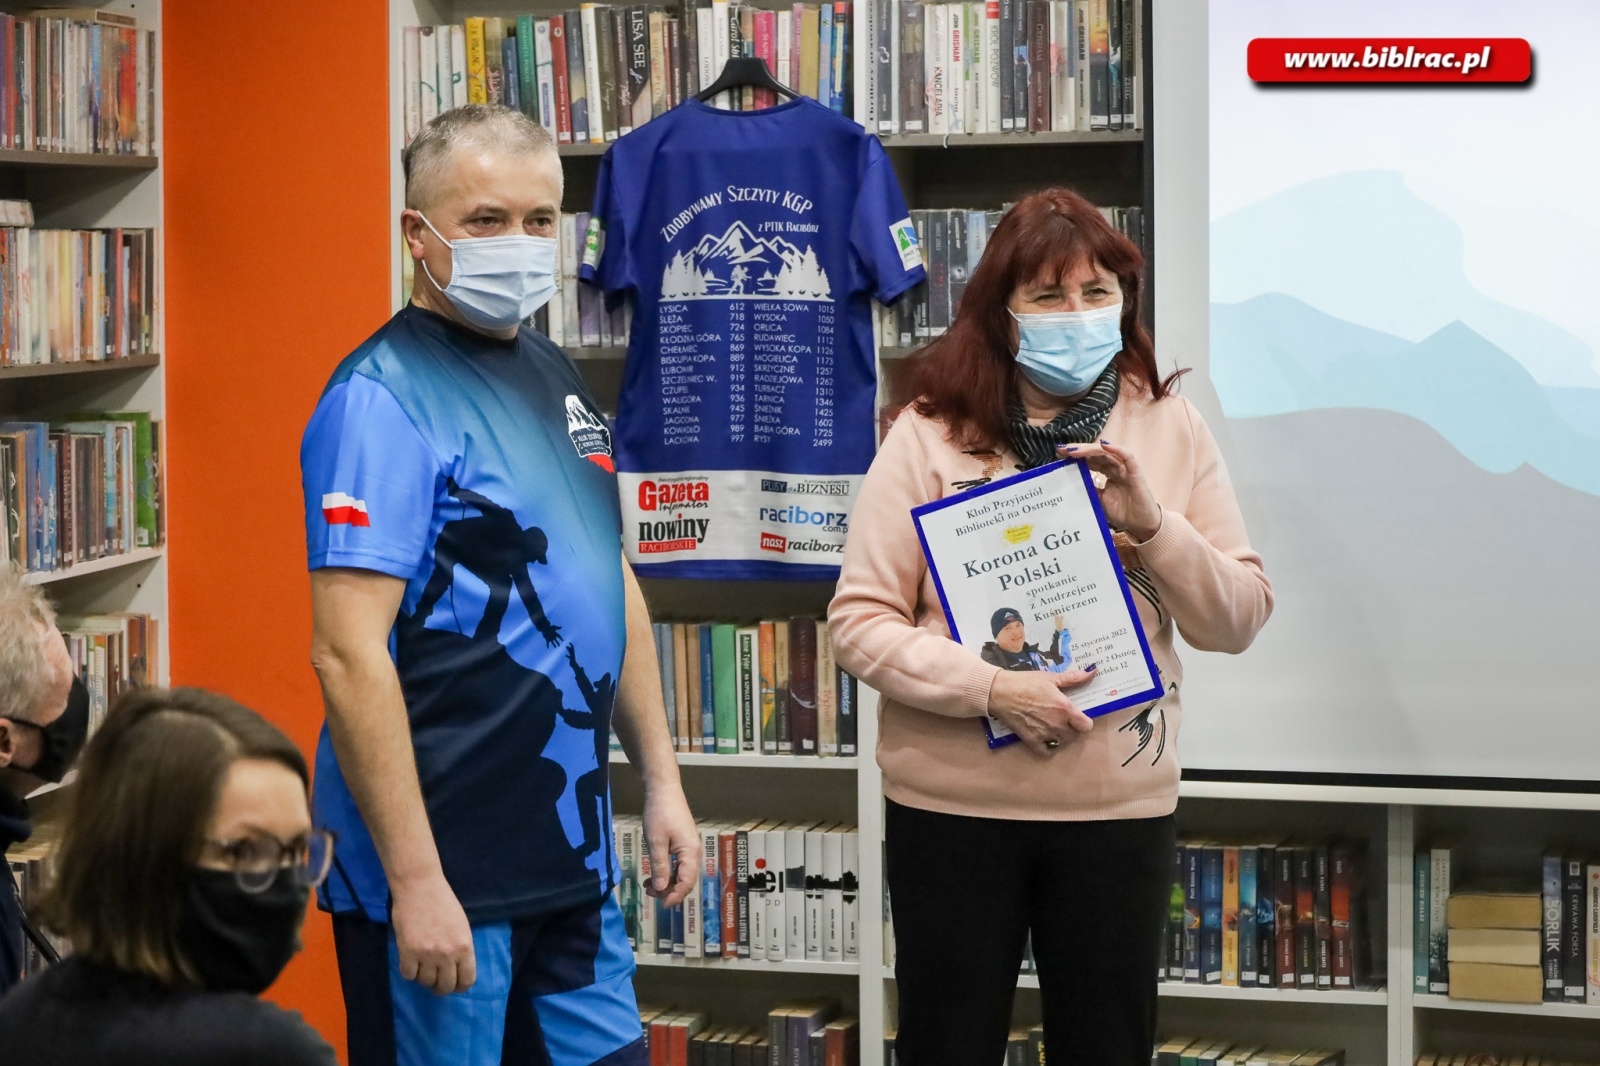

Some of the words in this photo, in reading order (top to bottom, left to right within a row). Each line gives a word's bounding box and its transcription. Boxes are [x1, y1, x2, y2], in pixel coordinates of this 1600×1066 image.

[632, 10, 643, 41] LISA
[1036, 24, 1044, 61] GRISHAM
[471, 38, 480, 66] ROWLING
[634, 44, 645, 68] SEE
[934, 67, 942, 116] KANCELARIA
[660, 192, 722, 243] ZDOBYWAMY
[727, 185, 780, 203] SZCZYTY
[782, 191, 813, 214] KGP
[765, 222, 783, 232] PTTK
[660, 305, 688, 313] ŁYSICA
[729, 303, 745, 311] 612
[754, 303, 780, 311] WIELKA
[783, 303, 809, 311] SOWA
[819, 305, 835, 313] 1015
[660, 325, 692, 334] SKOPIEC
[729, 323, 745, 331] 724
[819, 316, 834, 324] 1050
[696, 333, 721, 342] GÓRA
[818, 326, 833, 334] 1084
[730, 344, 745, 352] 869
[754, 334, 795, 342] RUDAWIEC
[818, 336, 833, 345] 1112
[754, 344, 785, 352] WYSOKA
[788, 345, 811, 353] KOPA
[817, 346, 833, 355] 1126
[817, 357, 833, 365] 1173
[816, 367, 833, 375] 1257
[754, 385, 785, 393] TURBACZ
[816, 388, 833, 396] 1310
[816, 378, 833, 386] 1262
[730, 394, 745, 402] 936
[816, 398, 833, 406] 1346
[815, 408, 833, 416] 1425
[776, 426, 800, 435] GÓRA
[814, 429, 833, 437] 1725
[815, 419, 833, 427] 1602
[754, 435, 771, 443] RYSY
[813, 439, 832, 447] 2499
[639, 480, 709, 511] Gazeta
[797, 483, 849, 495] BIZNESU
[966, 504, 991, 519] Klub
[993, 487, 1043, 510] Przyjaciół
[760, 506, 847, 526] raciborz
[955, 513, 1005, 537] Biblioteki
[1008, 510, 1020, 519] na
[1022, 495, 1063, 514] Ostrogu
[638, 513, 710, 543] nowiny
[823, 526, 848, 534] com.p
[763, 538, 783, 548] nasz
[962, 545, 1038, 578] Korona
[1043, 530, 1081, 551] Gór
[997, 558, 1062, 592] Polski
[1026, 574, 1078, 598] spotkanie
[1040, 582, 1097, 606] Andrzejem
[1033, 595, 1098, 622] Kuśnierzem
[1081, 635, 1110, 648] stycznia
[1111, 628, 1127, 638] 2022
[742, 654, 750, 670] Tyler
[1075, 651, 1095, 663] godz.
[1095, 644, 1114, 654] 17.00
[1111, 649, 1136, 660] Ostróg
[623, 833, 632, 854] ROBIN
[706, 836, 714, 857] ROBIN
[642, 857, 650, 876] COOK
[706, 858, 715, 877] COOK
[737, 839, 748, 882] GERRITSEN
[726, 892, 734, 928] CHIRURG
[1546, 899, 1559, 952] BORLIK
